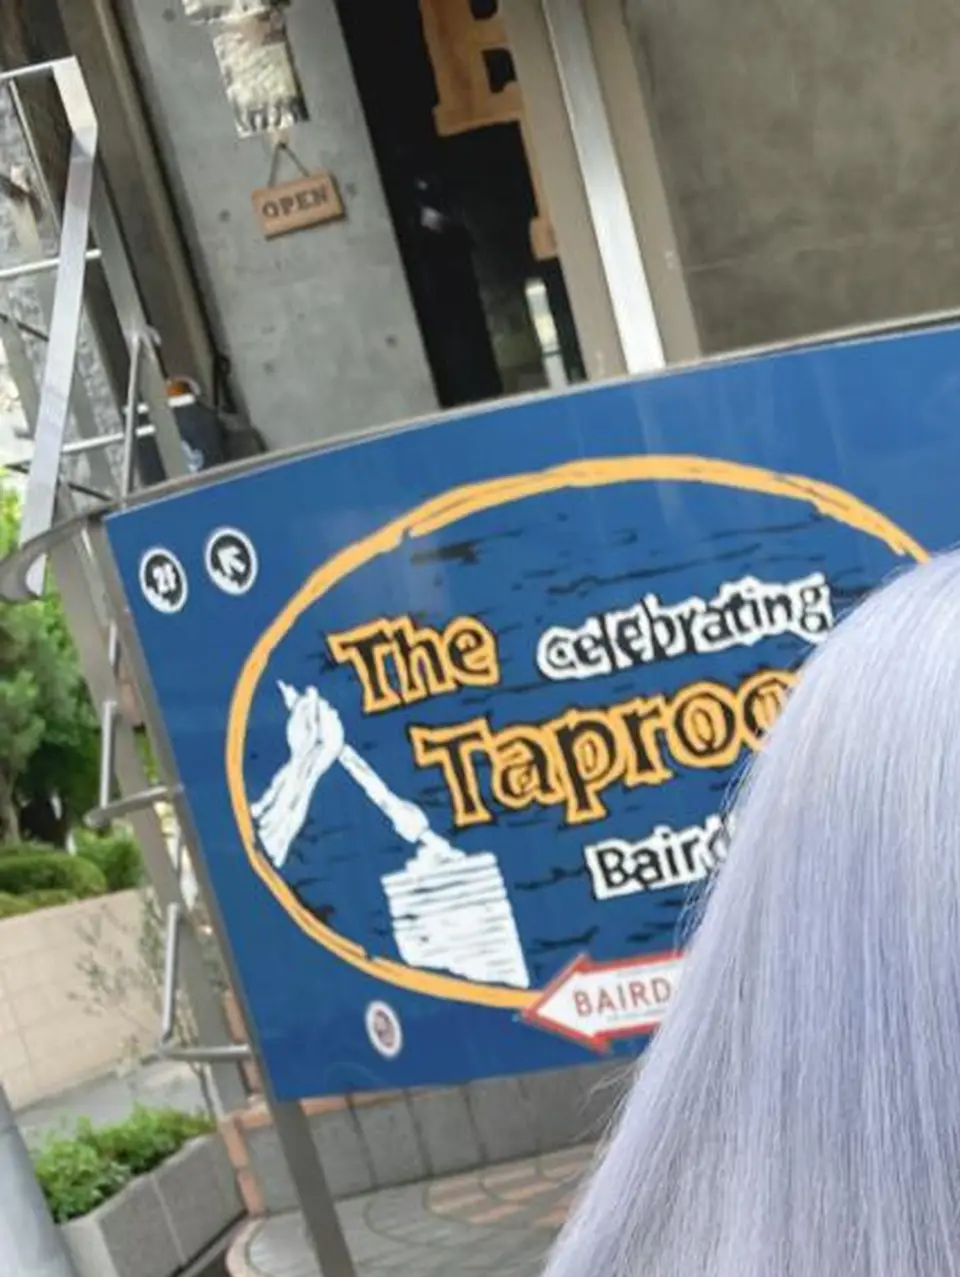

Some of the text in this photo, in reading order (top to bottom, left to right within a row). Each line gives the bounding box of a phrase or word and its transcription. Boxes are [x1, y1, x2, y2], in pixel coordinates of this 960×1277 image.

[261, 183, 328, 219] OPEN
[540, 574, 833, 678] celebrating
[330, 617, 497, 711] The
[573, 977, 673, 1017] BAIRD
